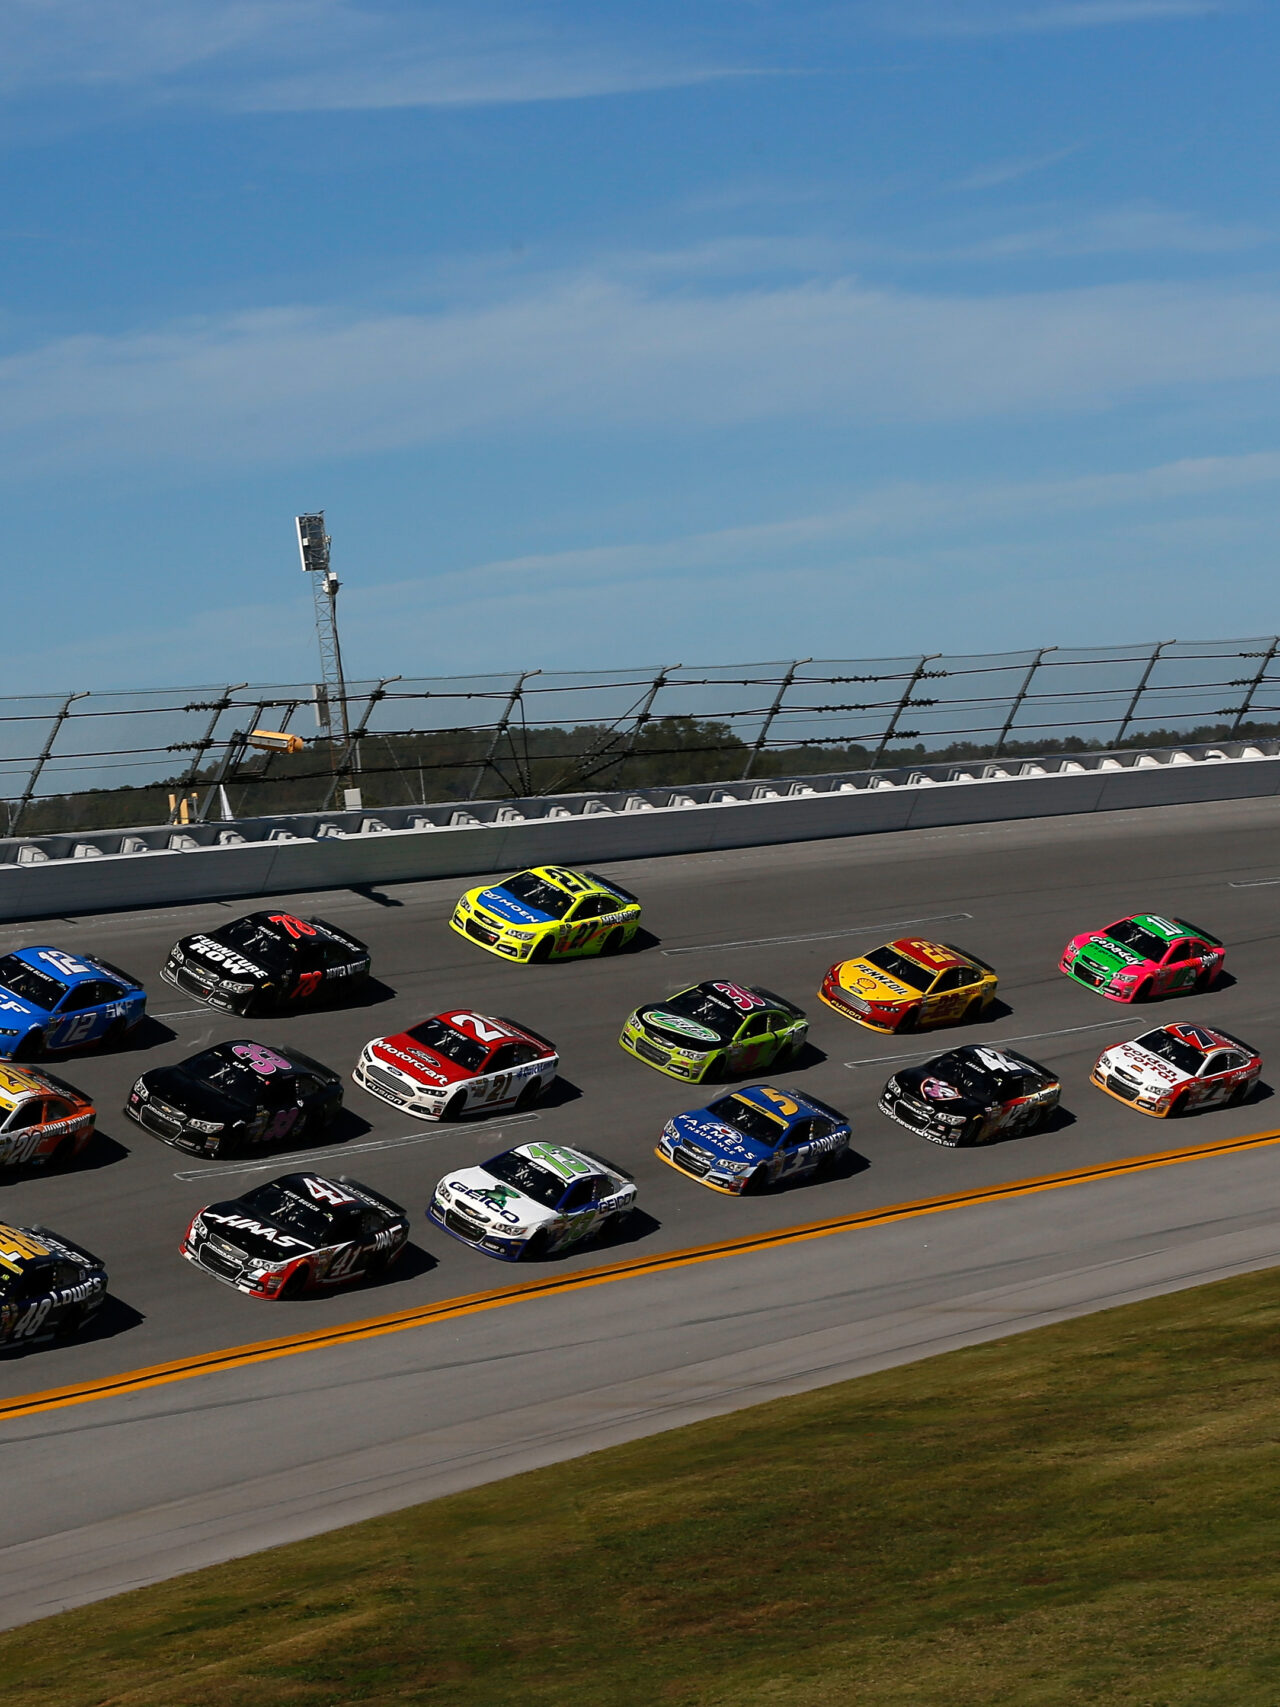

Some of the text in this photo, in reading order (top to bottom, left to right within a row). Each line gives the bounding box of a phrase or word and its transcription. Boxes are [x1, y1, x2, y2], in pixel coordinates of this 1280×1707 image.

[543, 867, 593, 894] 27
[498, 898, 539, 923] MOEN
[601, 910, 638, 925] MENARDS
[268, 914, 317, 939] 78
[37, 950, 91, 975] 12
[189, 943, 250, 975] ROW
[191, 935, 269, 979] FURNITURE
[290, 970, 322, 998] 78
[852, 963, 910, 995] PENNZOIL
[106, 999, 134, 1019] SKF
[712, 982, 766, 1011] 36
[831, 999, 862, 1021] FUSION
[61, 1012, 98, 1042] 12
[1176, 1024, 1216, 1049] 7
[231, 1043, 293, 1075] 33
[373, 1040, 450, 1086] Motorcraft
[974, 1047, 1022, 1072] 42
[1119, 1044, 1178, 1077] golden
[1124, 1052, 1178, 1084] corral
[367, 1081, 403, 1106] FUSION
[759, 1088, 799, 1116] 5
[678, 1114, 757, 1161] FARMERS
[683, 1123, 736, 1156] INSURANCE
[809, 1130, 847, 1155] FARMERS
[527, 1143, 590, 1179] 13
[302, 1176, 358, 1207] 41
[448, 1181, 520, 1224] GEICO
[599, 1193, 631, 1214] GEICO
[203, 1212, 316, 1249] HAAS
[330, 1246, 361, 1275] 41
[50, 1277, 102, 1308] LOWE'S
[15, 1298, 53, 1339] 48
